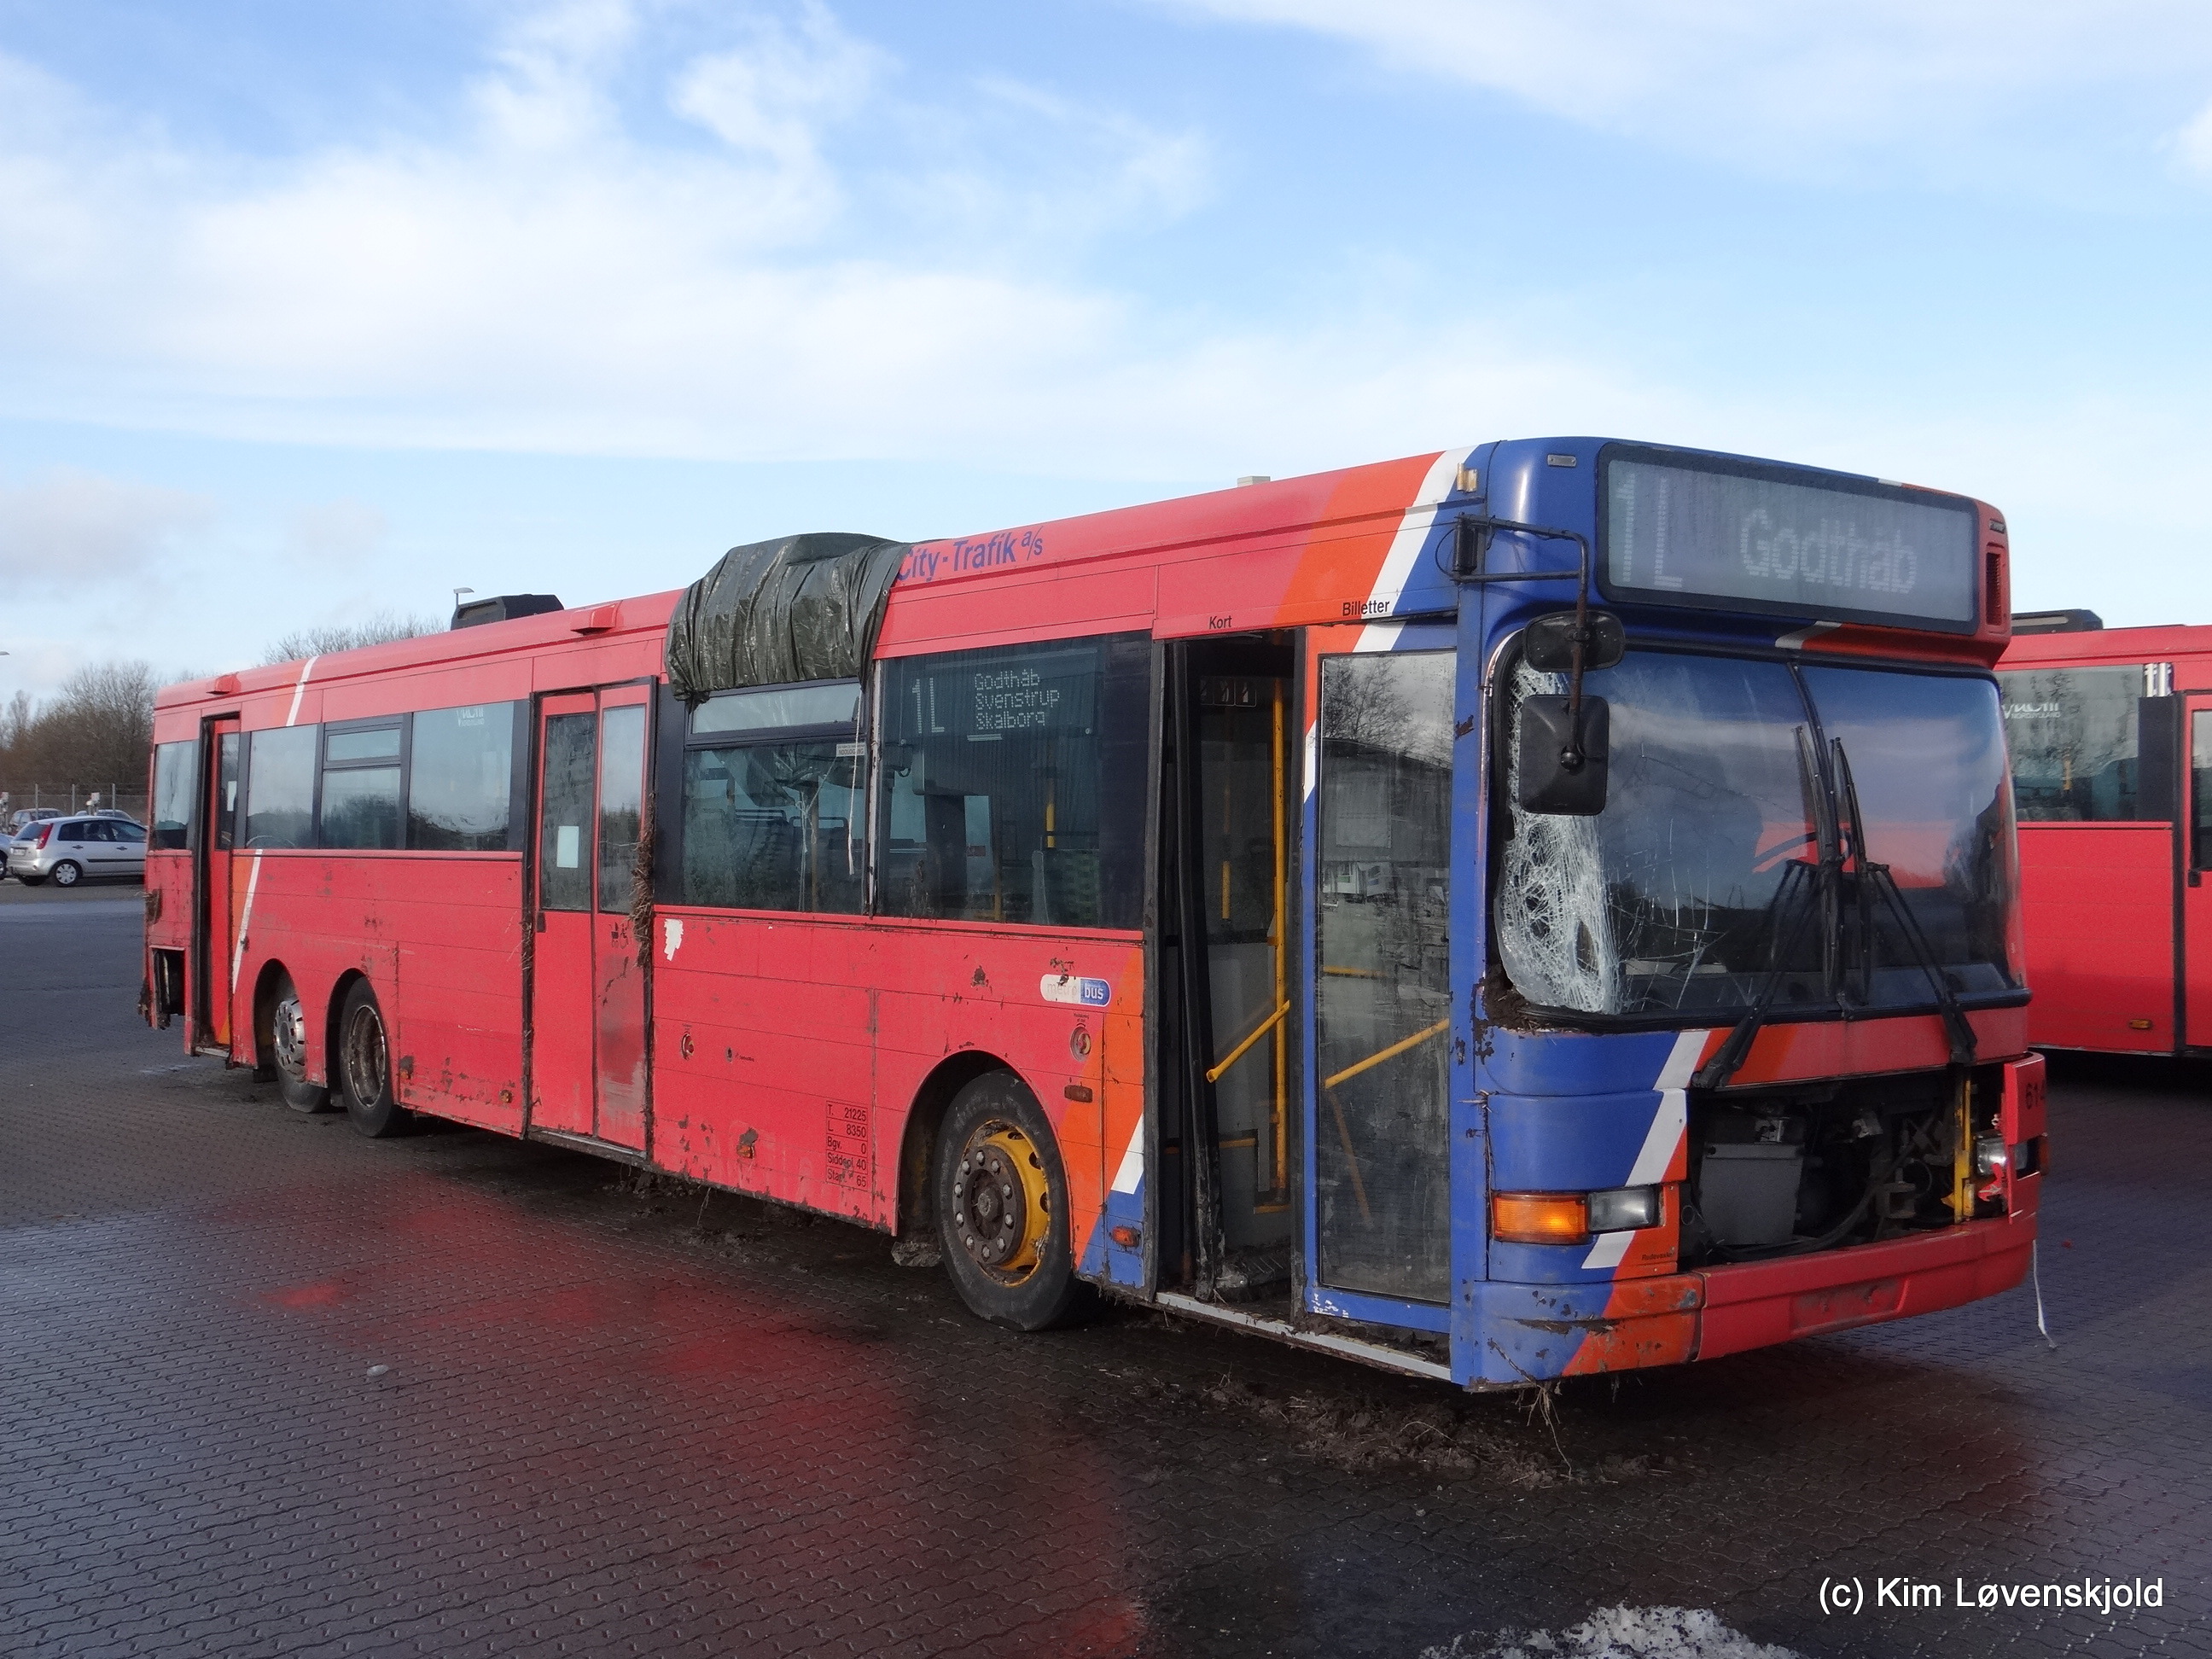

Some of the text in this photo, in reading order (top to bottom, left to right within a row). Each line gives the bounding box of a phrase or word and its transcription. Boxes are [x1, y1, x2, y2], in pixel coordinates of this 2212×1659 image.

[1342, 599, 1390, 617] Billetter
[1208, 615, 1232, 629] Kort
[975, 689, 1060, 710] Svenstrup
[1084, 982, 1103, 999] bus
[844, 1107, 866, 1121] 21225
[846, 1123, 866, 1138] 8350
[861, 1143, 866, 1155] 0
[856, 1158, 866, 1170] 40
[856, 1175, 866, 1187] 65
